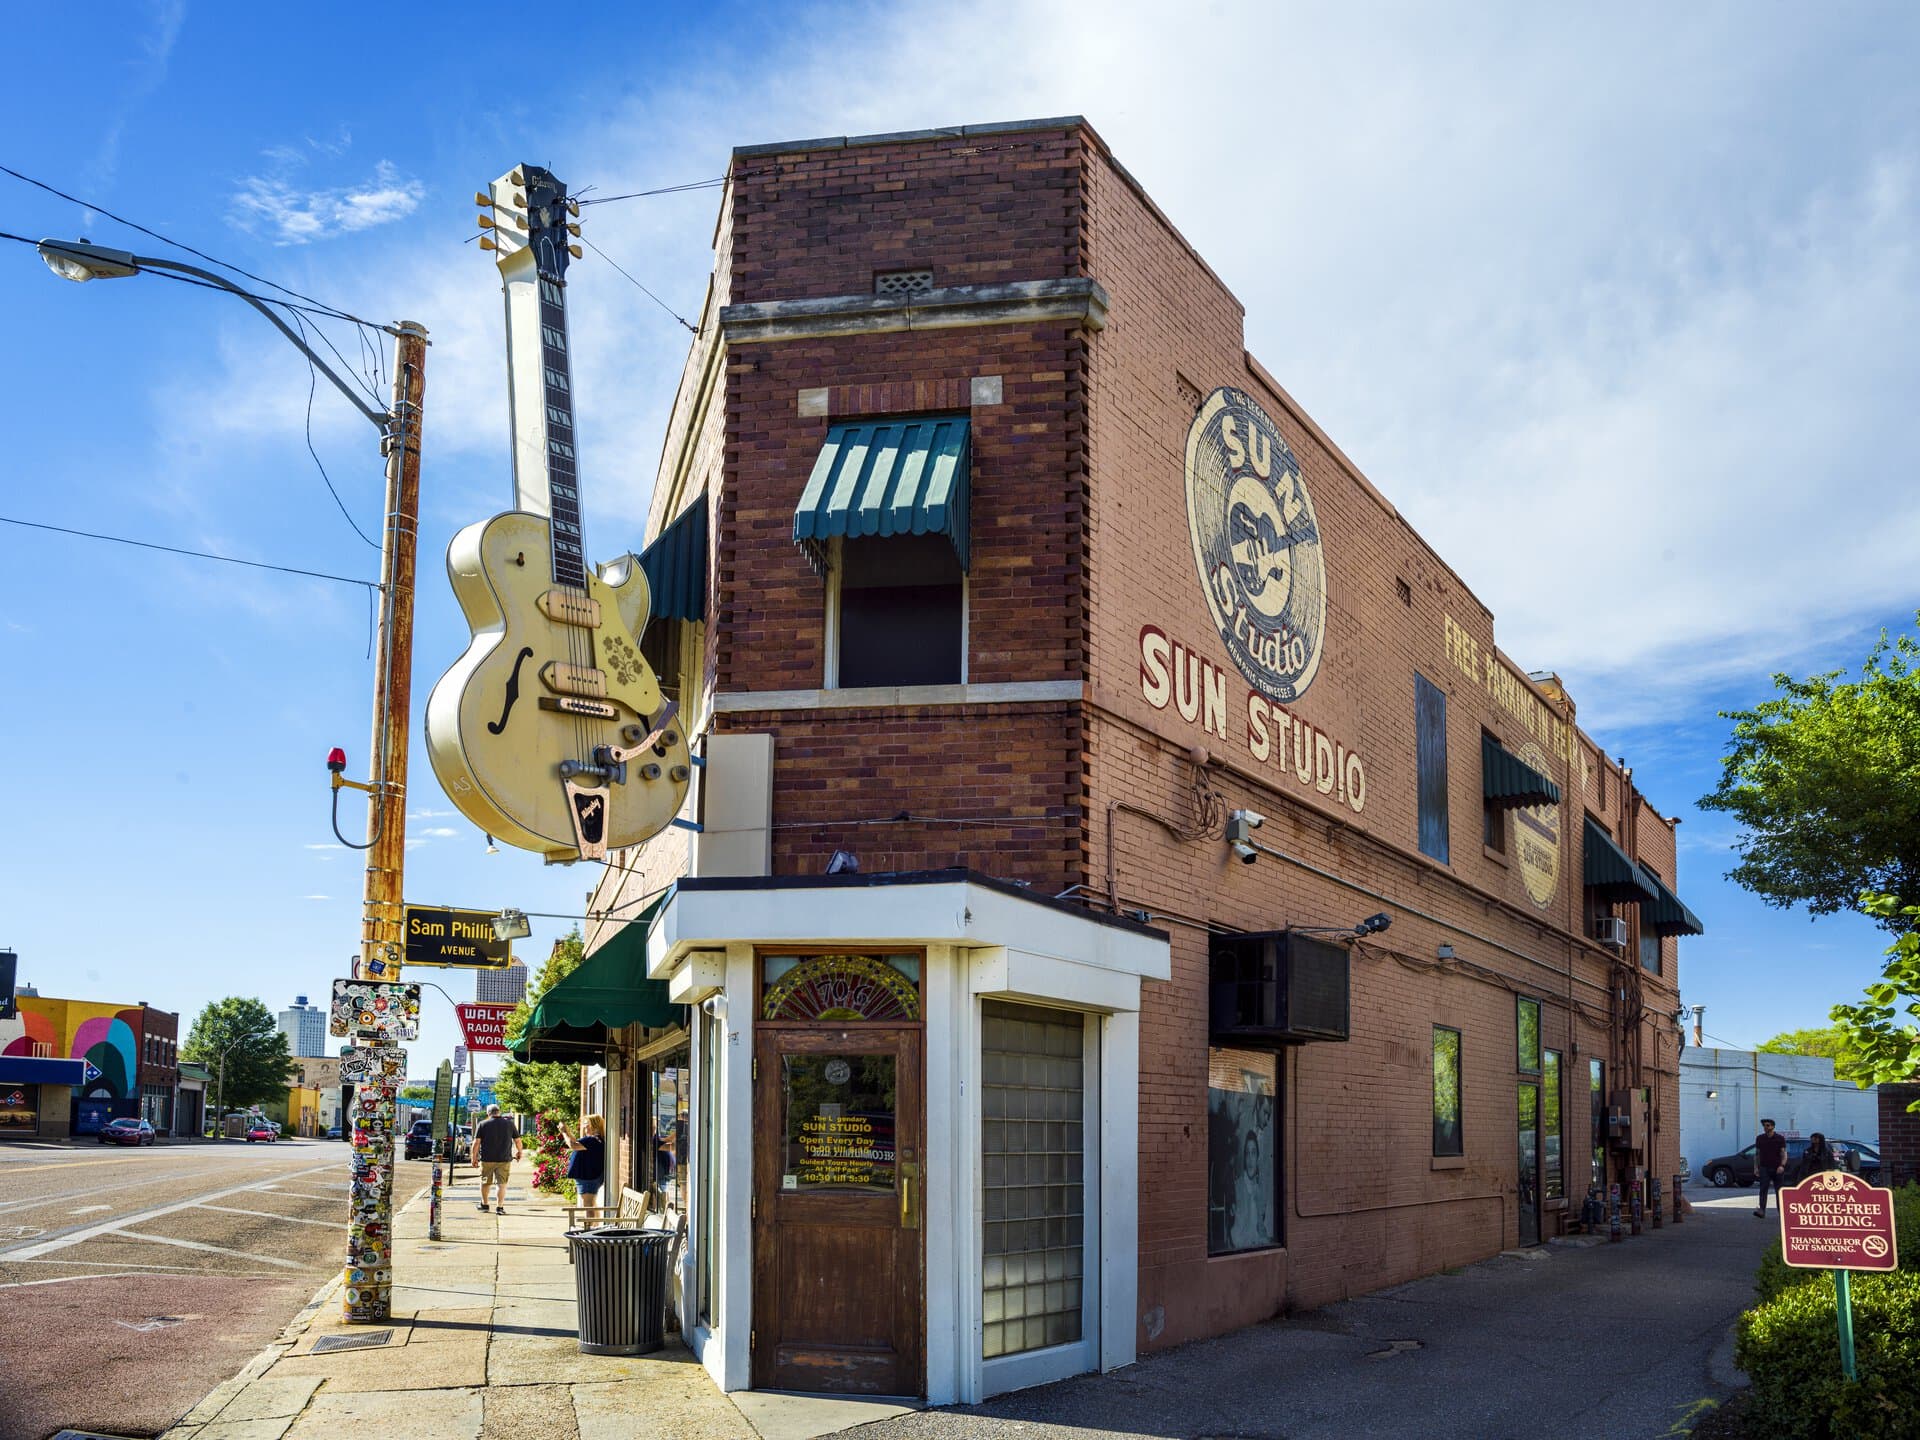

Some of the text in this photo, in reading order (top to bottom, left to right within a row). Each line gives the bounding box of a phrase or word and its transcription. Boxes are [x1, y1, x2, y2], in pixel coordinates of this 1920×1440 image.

[1232, 392, 1289, 453] THE LEGENDARY
[1221, 415, 1302, 525] SUN
[1211, 562, 1305, 675] Studio
[1258, 679, 1292, 698] TENNESSEE
[1445, 613, 1579, 772] FREE PARKING IN RER
[1139, 624, 1366, 813] SUN STUDIO
[411, 919, 497, 943] Sam Phillip
[440, 945, 476, 956] AVENUE
[817, 980, 868, 1005] 706
[465, 1008, 506, 1020] WALK
[467, 1023, 507, 1033] RADIAT
[474, 1036, 505, 1046] WOR
[829, 1115, 867, 1124] Lgendary
[802, 1122, 872, 1132] SUN STUDIO
[799, 1136, 875, 1147] Open Every Day
[799, 1159, 825, 1167] Guided
[849, 1160, 874, 1168] Hourly
[805, 1174, 831, 1182] 10:30
[833, 1174, 846, 1182] till
[1811, 1194, 1856, 1203] THIS IS A
[1789, 1203, 1882, 1215] SMOKE-FREE
[1799, 1215, 1876, 1227] BUILDING.
[1790, 1237, 1861, 1246] THANK YOU FOR
[1791, 1243, 1856, 1253] NOT SMOKING.
